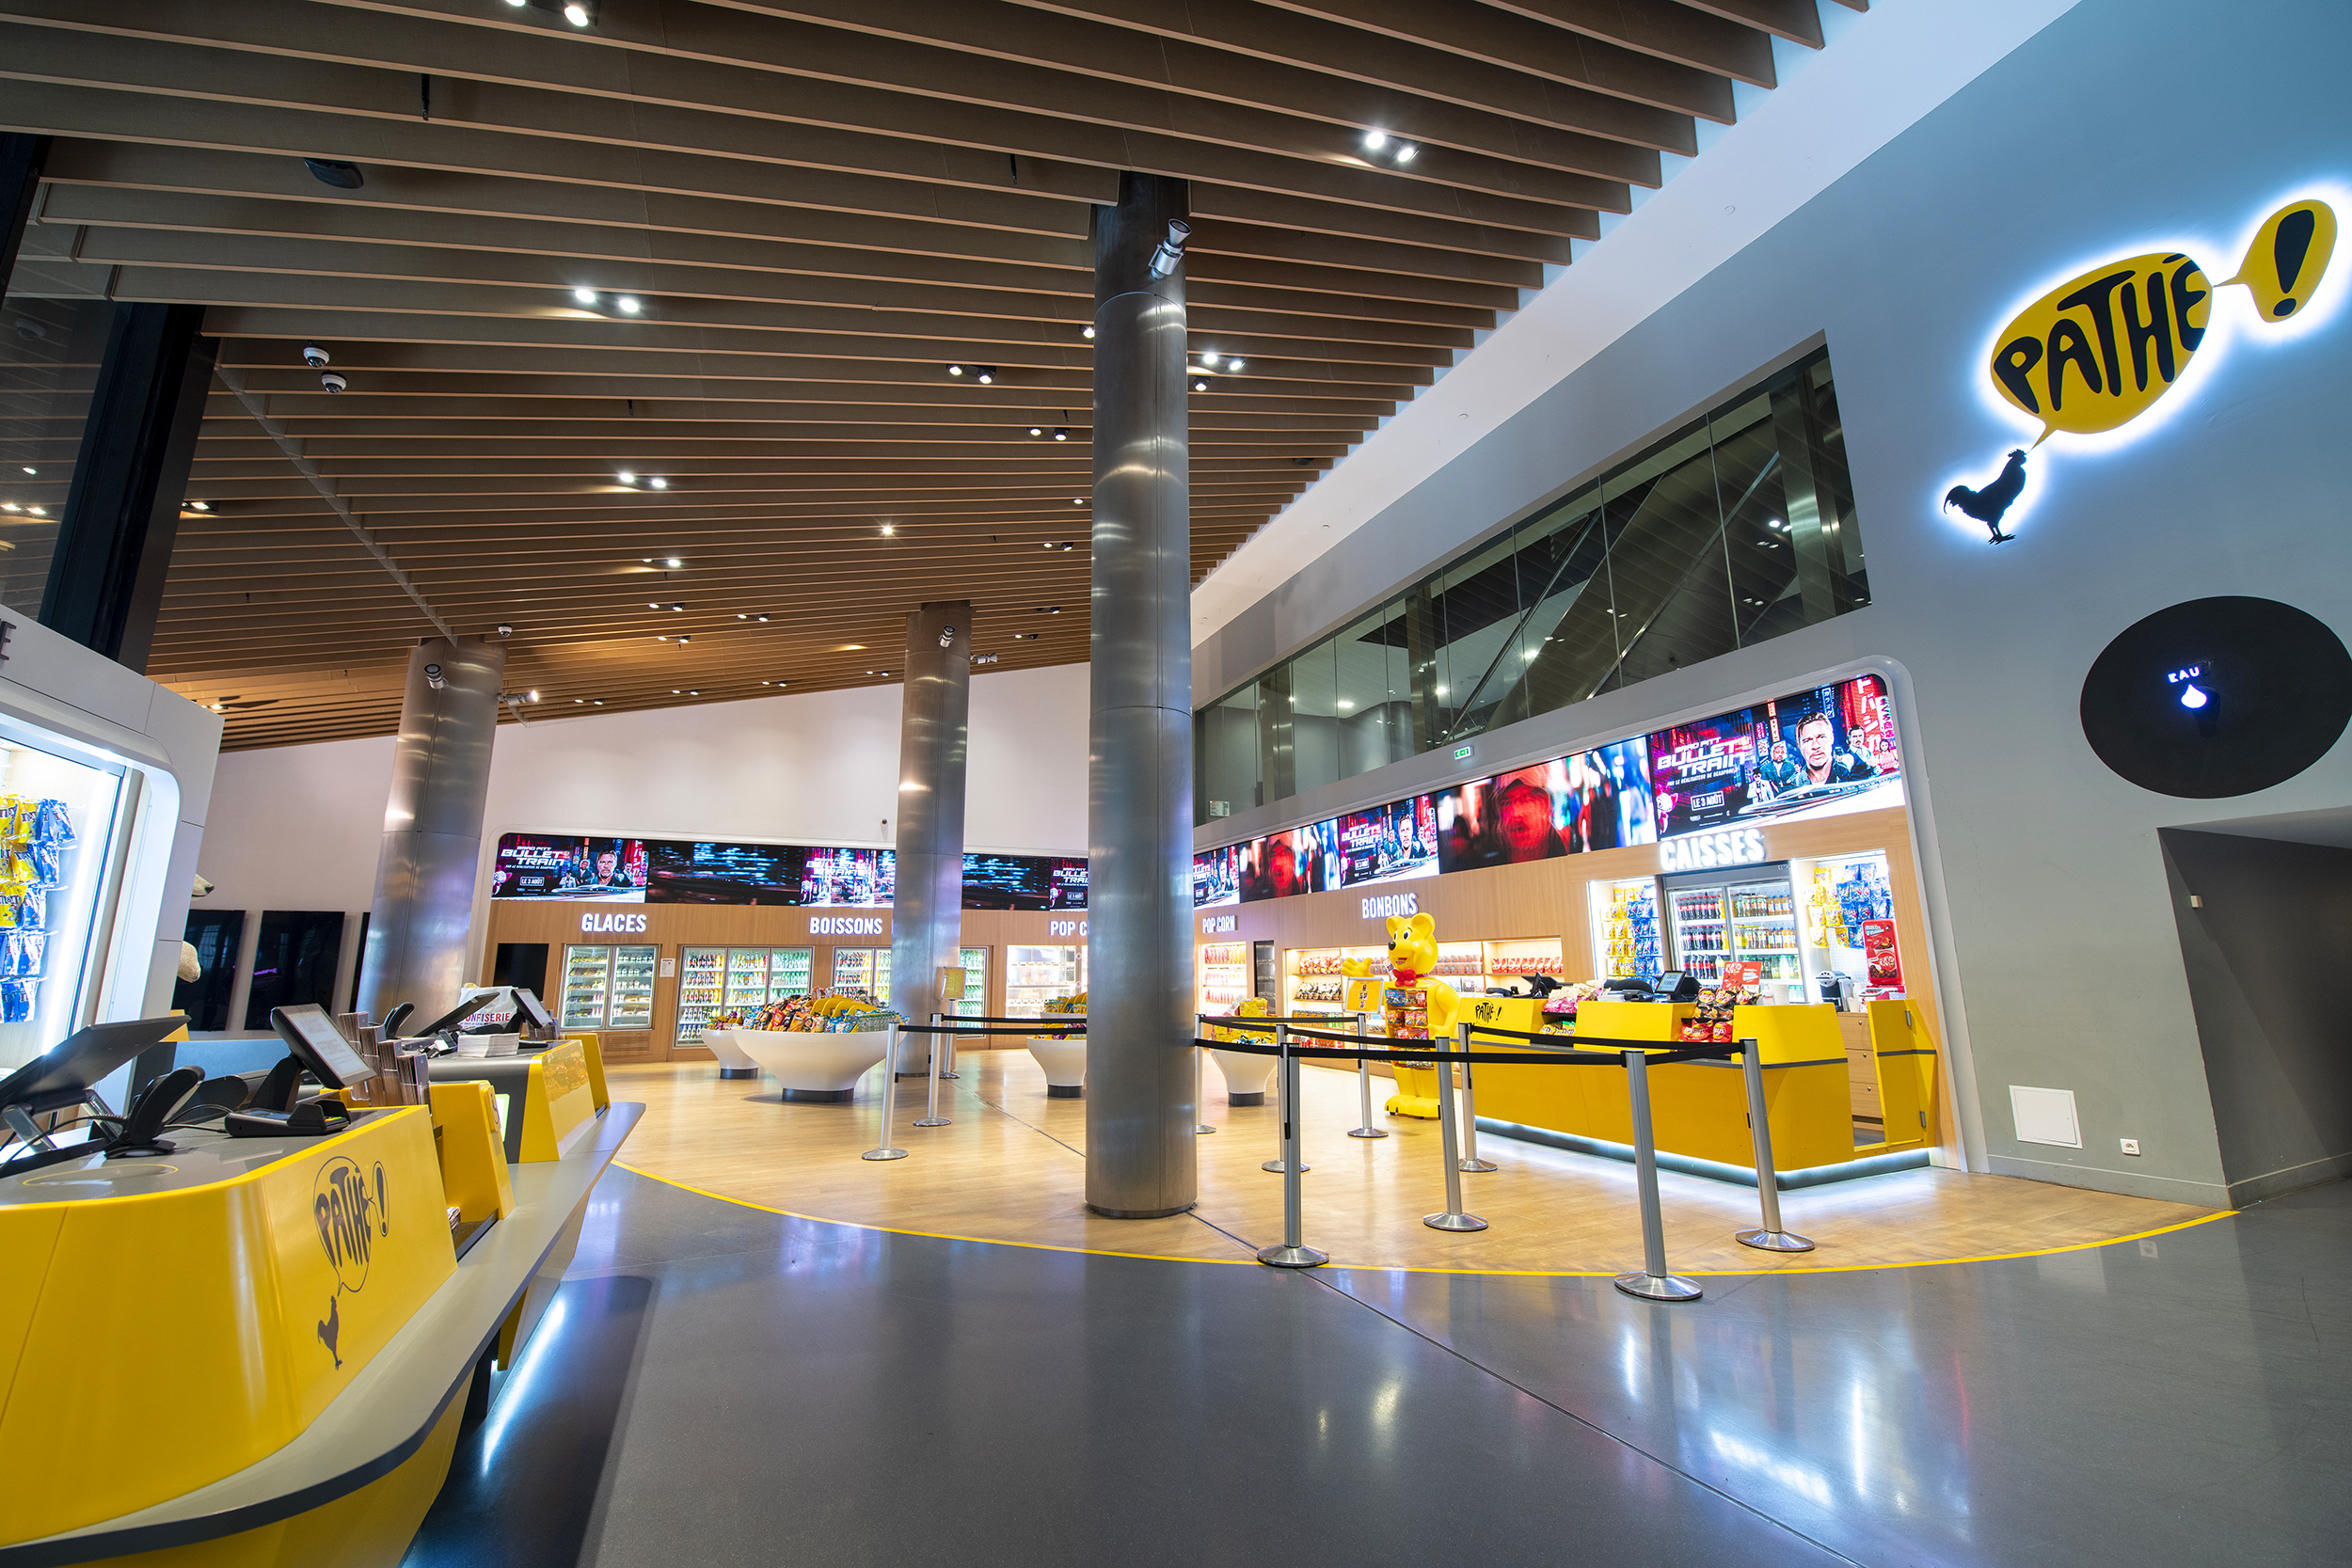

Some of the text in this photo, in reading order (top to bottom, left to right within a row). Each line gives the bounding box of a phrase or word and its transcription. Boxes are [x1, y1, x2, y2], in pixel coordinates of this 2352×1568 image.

[2168, 666, 2200, 683] EAU
[1658, 739, 1739, 769] BULLET
[1677, 752, 1746, 778] TRAIN
[1342, 827, 1374, 842] BULLET
[501, 849, 563, 858] BULLET
[1660, 829, 1765, 872] CAISSES
[516, 857, 564, 866] TRAIN
[1361, 892, 1419, 919] BONBONS
[580, 912, 646, 933] GLACES
[810, 917, 882, 936] BOISSONS
[1050, 921, 1075, 937] POP
[1202, 915, 1235, 934] POP CORN
